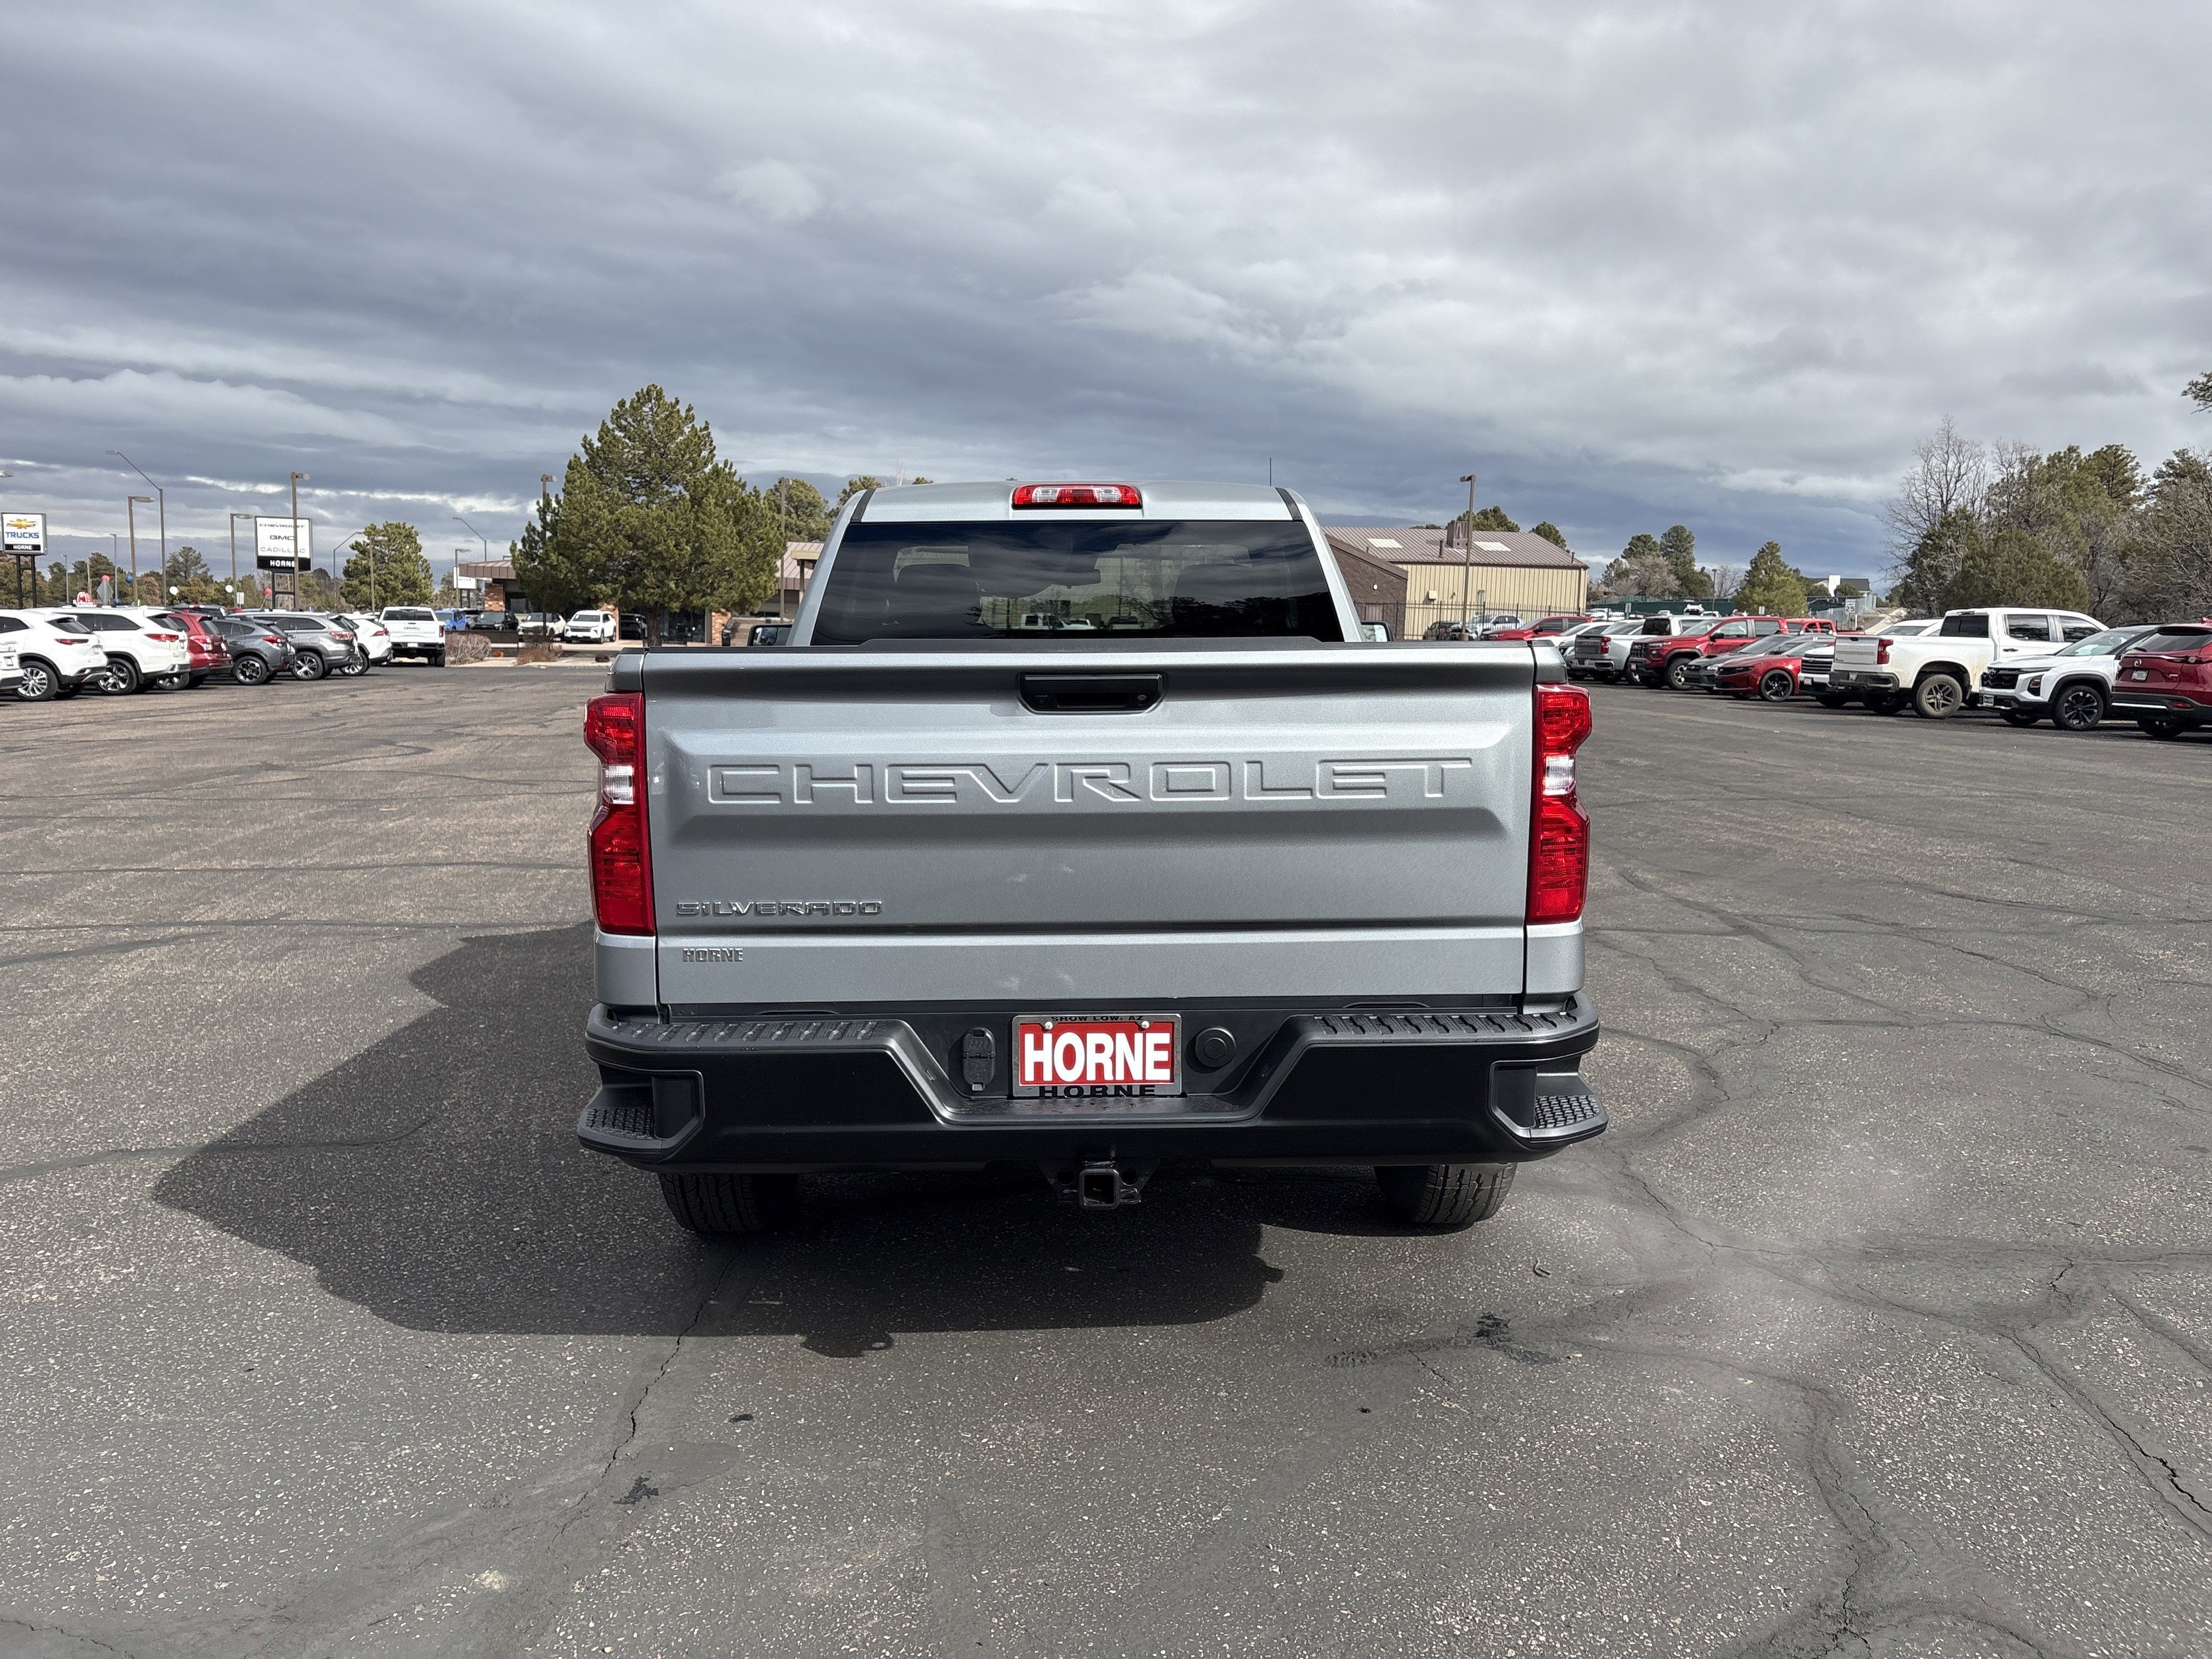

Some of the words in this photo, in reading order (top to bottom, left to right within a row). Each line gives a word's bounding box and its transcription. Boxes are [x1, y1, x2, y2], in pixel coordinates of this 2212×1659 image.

[708, 757, 1472, 804] CHEVROLET
[676, 900, 884, 916] SILVERADO
[682, 948, 743, 962] HORNE
[1024, 1032, 1171, 1082] HORNE
[1039, 1085, 1156, 1098] HORNE
